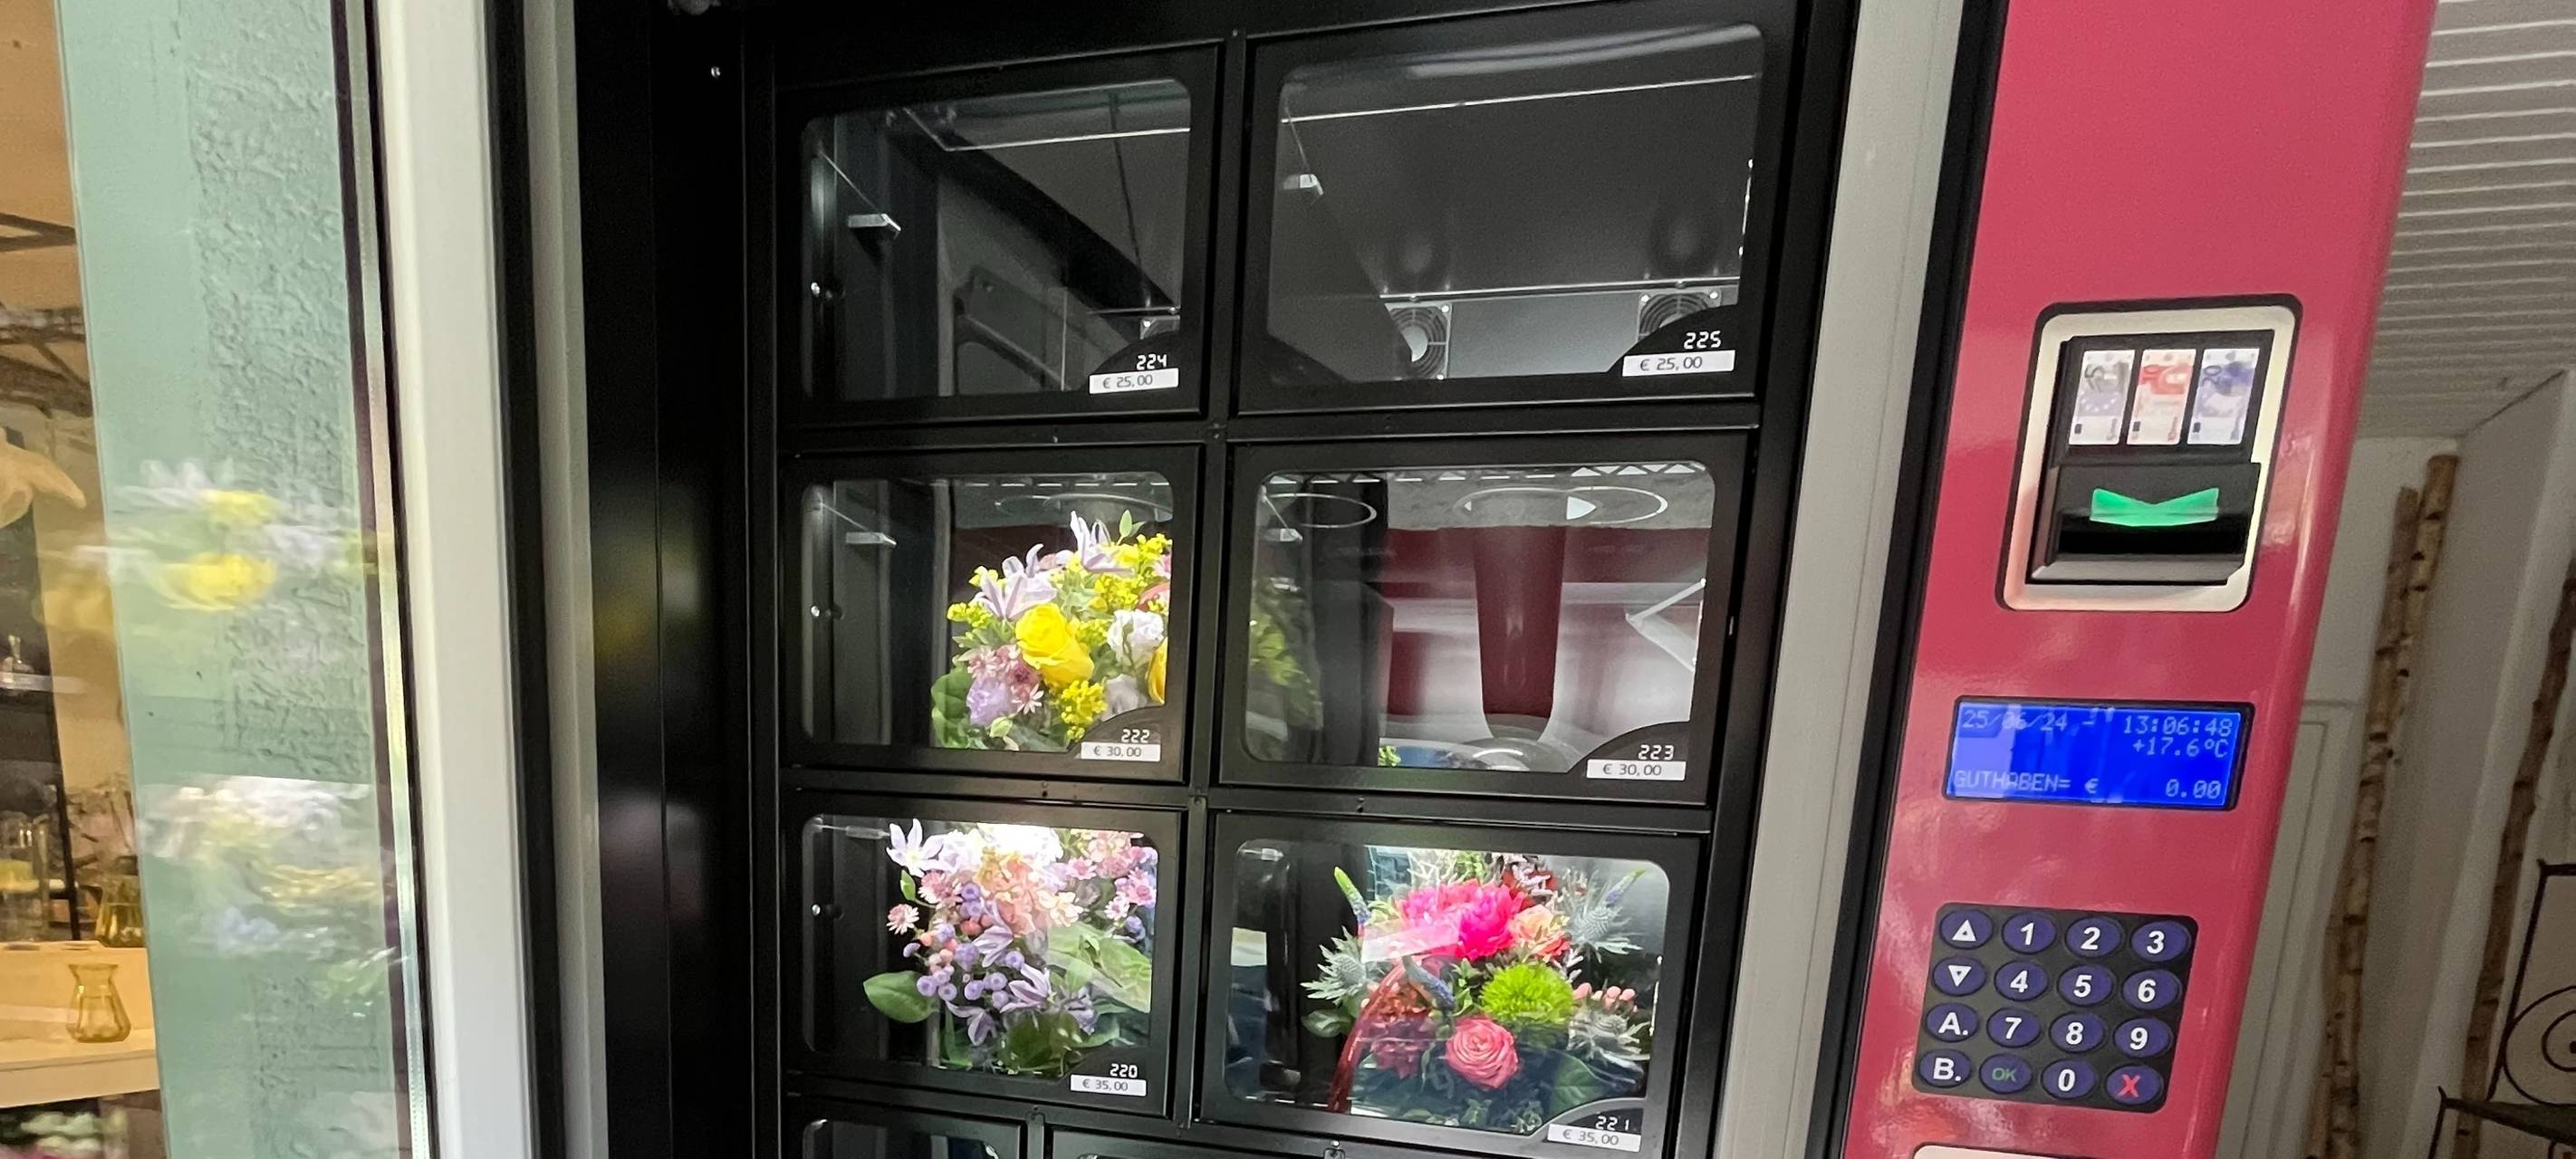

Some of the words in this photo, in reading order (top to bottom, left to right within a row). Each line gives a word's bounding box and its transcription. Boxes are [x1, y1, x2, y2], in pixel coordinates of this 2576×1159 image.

[1684, 330, 1721, 350] 225
[1136, 353, 1168, 371] 224
[1640, 359, 1650, 371] €
[1657, 356, 1703, 371] 25,00
[1102, 377, 1110, 389] €
[1120, 728, 1150, 743] 222
[2124, 715, 2234, 738] 13:06:48
[1093, 745, 1101, 757] €
[1638, 744, 1674, 761] 223
[1603, 763, 1613, 775] €
[2084, 778, 2100, 794] €
[2166, 779, 2223, 800] 0.00
[2021, 922, 2034, 945] 1
[2081, 926, 2101, 950] 2
[2146, 931, 2165, 954] 3
[2010, 970, 2028, 993] 4
[2073, 974, 2092, 998] 5
[2138, 979, 2157, 1002] 6
[1938, 1011, 1969, 1036] A.
[2004, 1017, 2022, 1039] 7
[2065, 1021, 2084, 1045] 8
[2129, 1027, 2148, 1050] 9
[1110, 1063, 1139, 1078] 220
[1933, 1058, 1963, 1082] B.
[1992, 1068, 2018, 1082] OK
[2057, 1068, 2076, 1092] 0
[1082, 1078, 1090, 1089] €
[1562, 1128, 1572, 1140] €
[1595, 1116, 1629, 1131] 221
